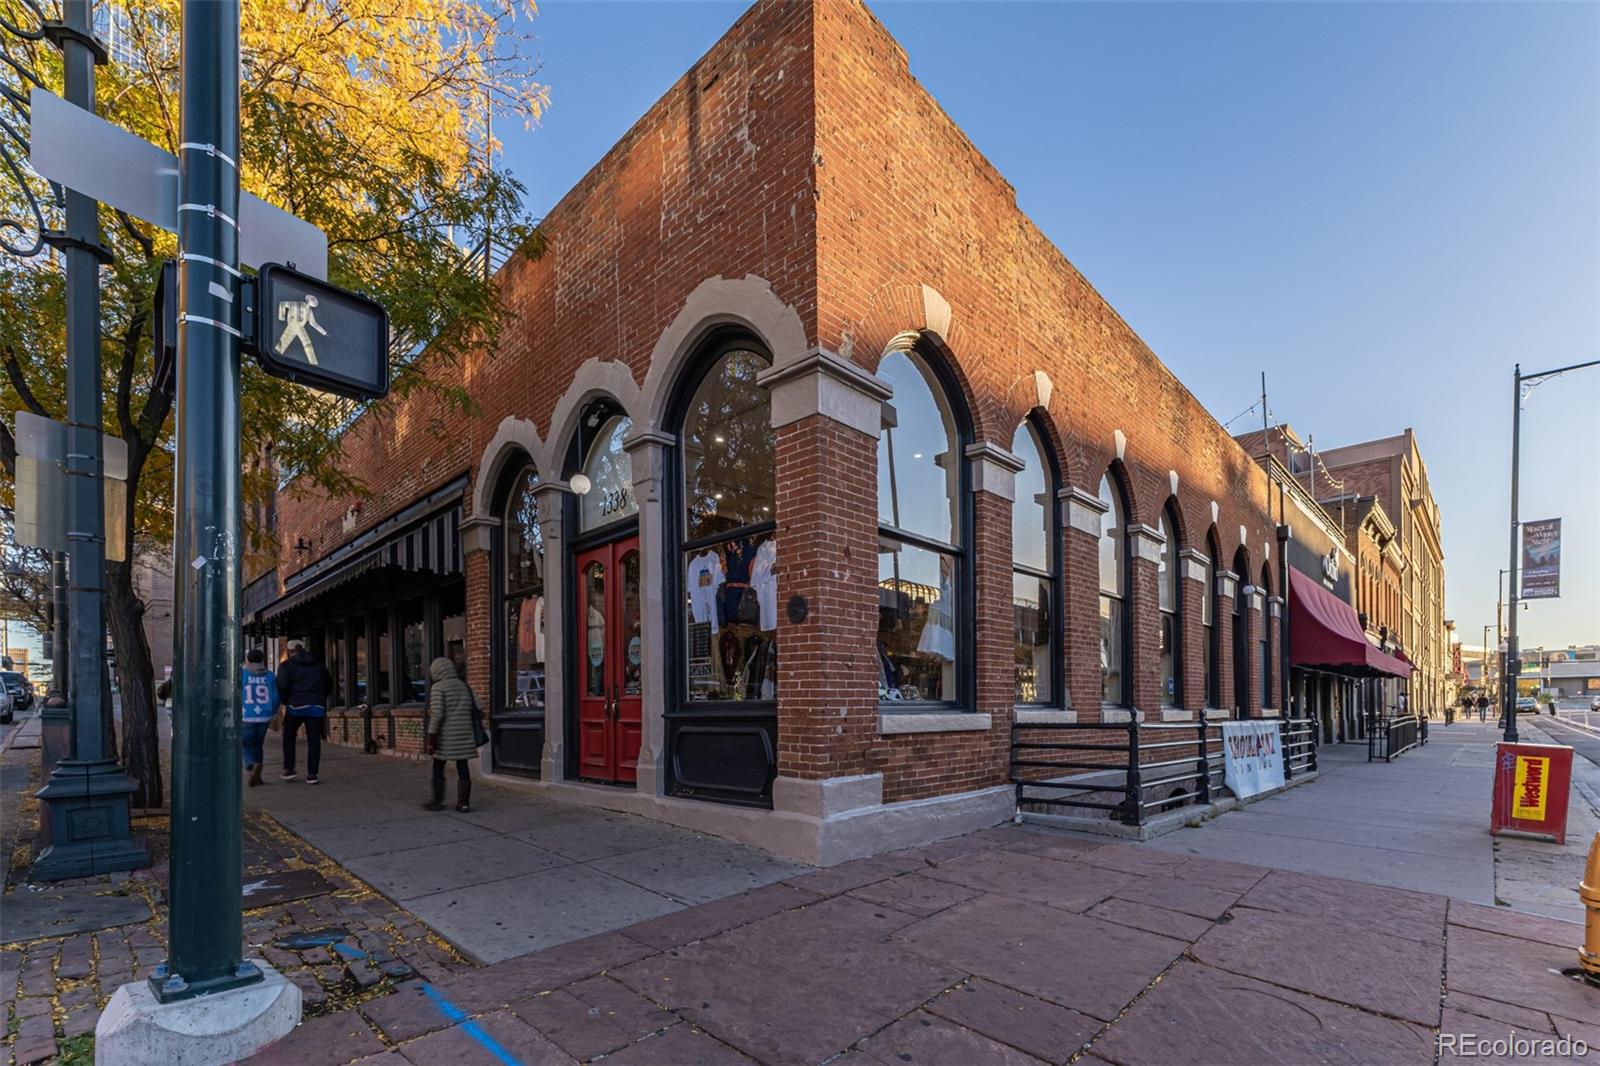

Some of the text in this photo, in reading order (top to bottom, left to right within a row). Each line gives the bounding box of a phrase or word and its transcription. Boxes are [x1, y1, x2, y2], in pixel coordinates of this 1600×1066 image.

[602, 487, 628, 516] 1338
[244, 684, 270, 704] 19
[1519, 758, 1543, 808] Westword
